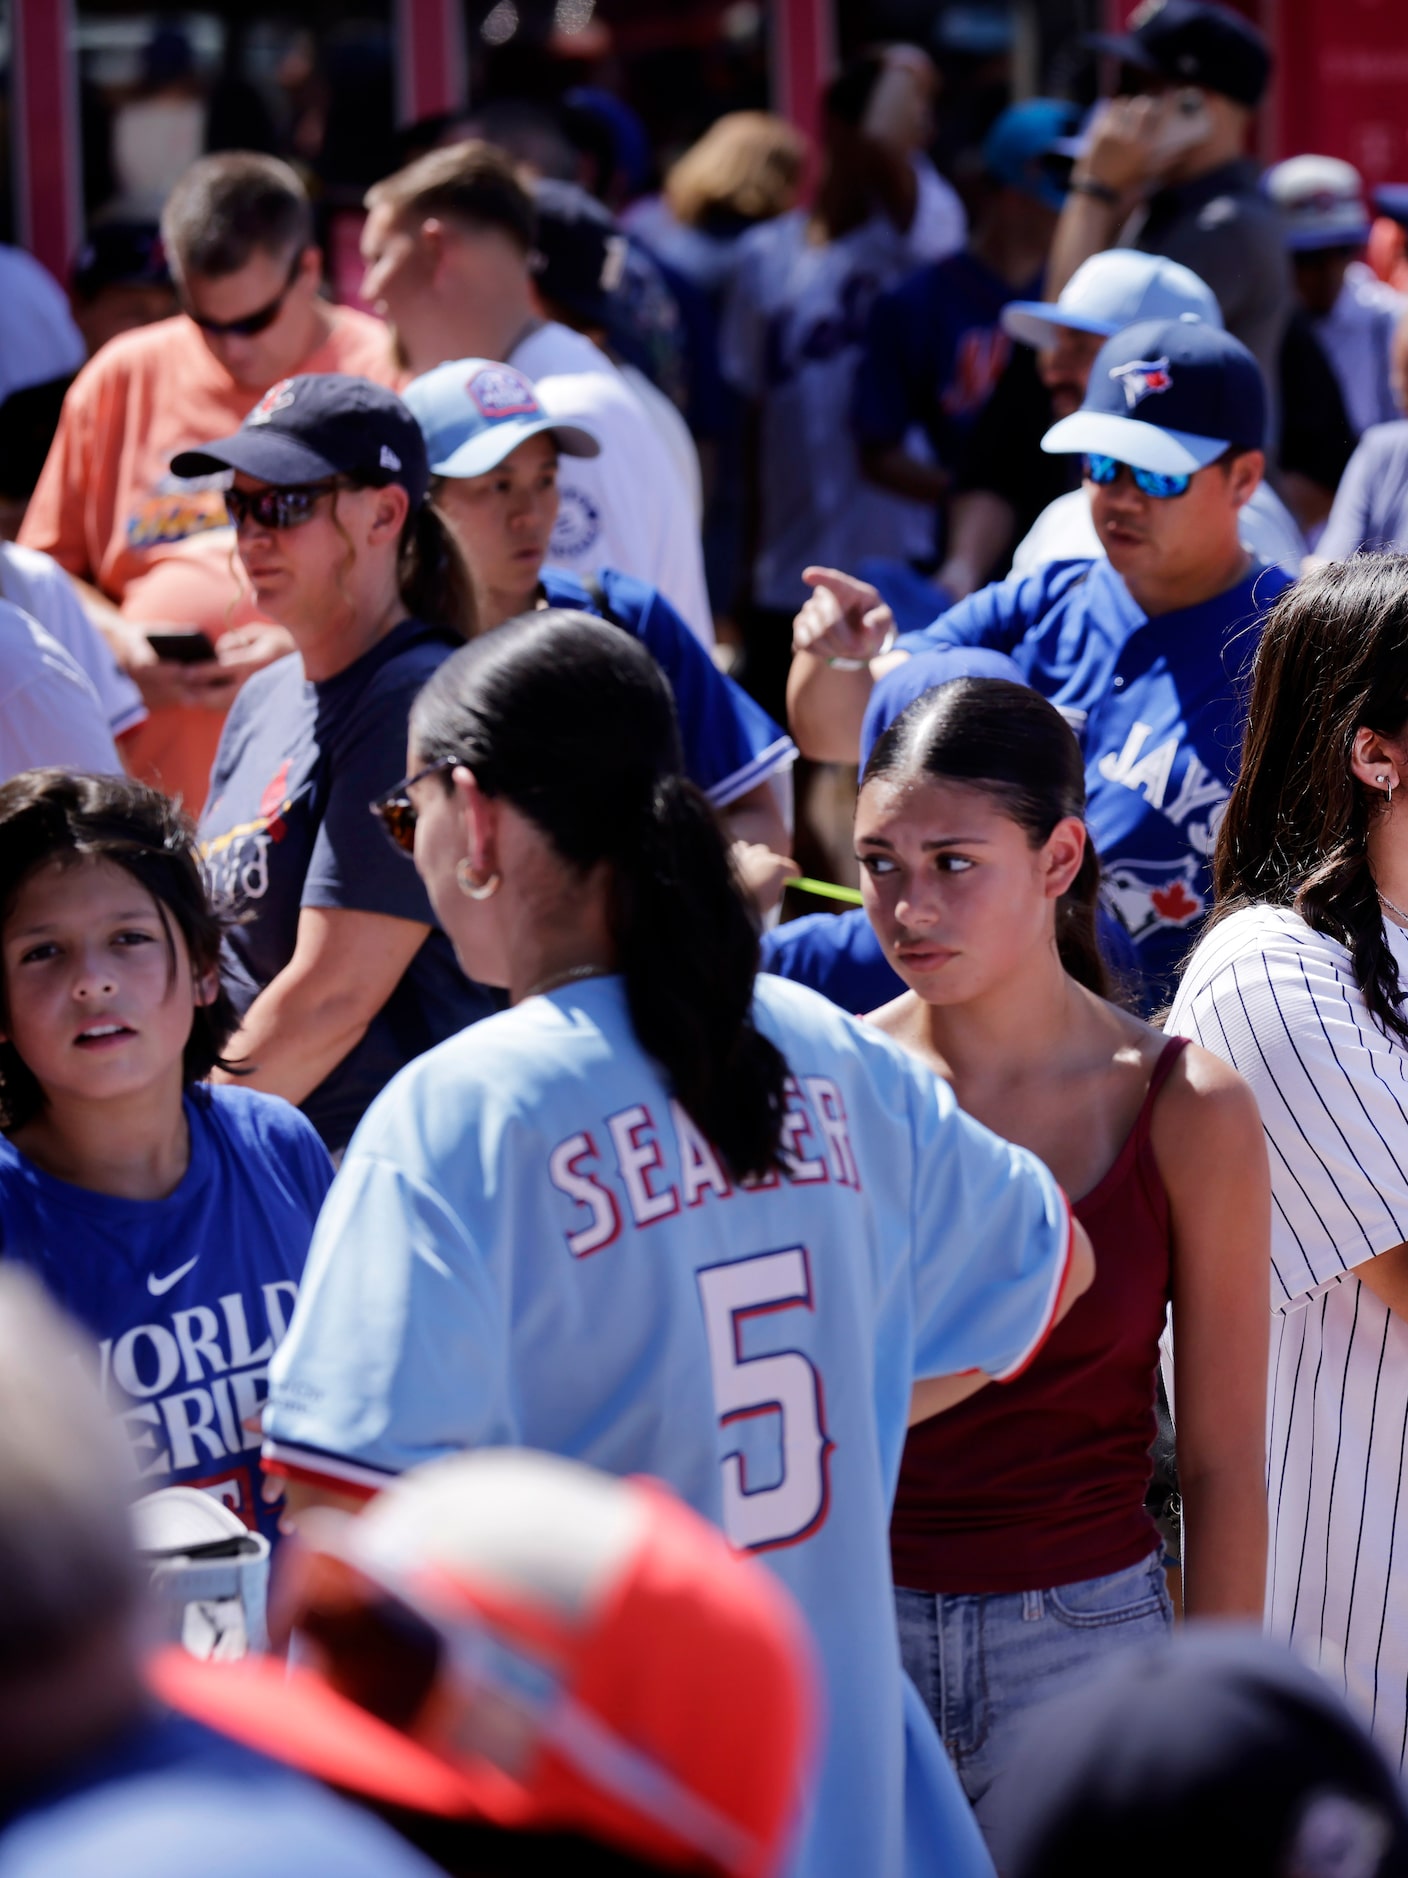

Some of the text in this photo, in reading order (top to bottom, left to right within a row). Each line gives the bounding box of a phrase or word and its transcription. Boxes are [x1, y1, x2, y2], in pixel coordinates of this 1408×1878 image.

[549, 1074, 863, 1260] SEAER
[98, 1280, 299, 1398] ORLD
[695, 1243, 837, 1560] 5
